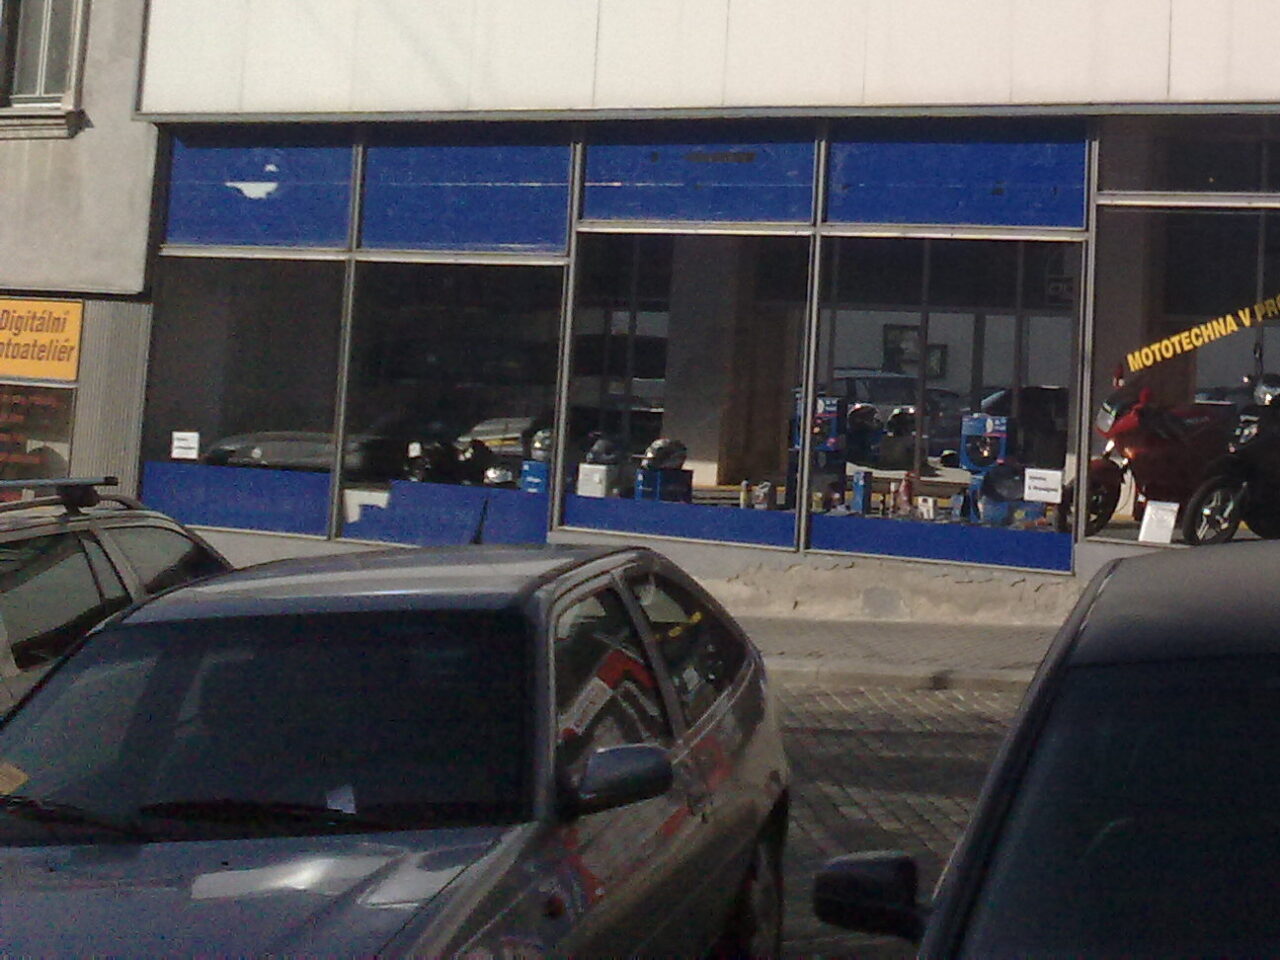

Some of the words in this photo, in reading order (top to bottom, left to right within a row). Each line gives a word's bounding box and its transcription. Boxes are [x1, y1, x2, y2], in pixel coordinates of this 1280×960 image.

[0, 308, 69, 337] Digitální
[1126, 315, 1239, 373] MOTOTECHNA
[1237, 307, 1251, 328] V
